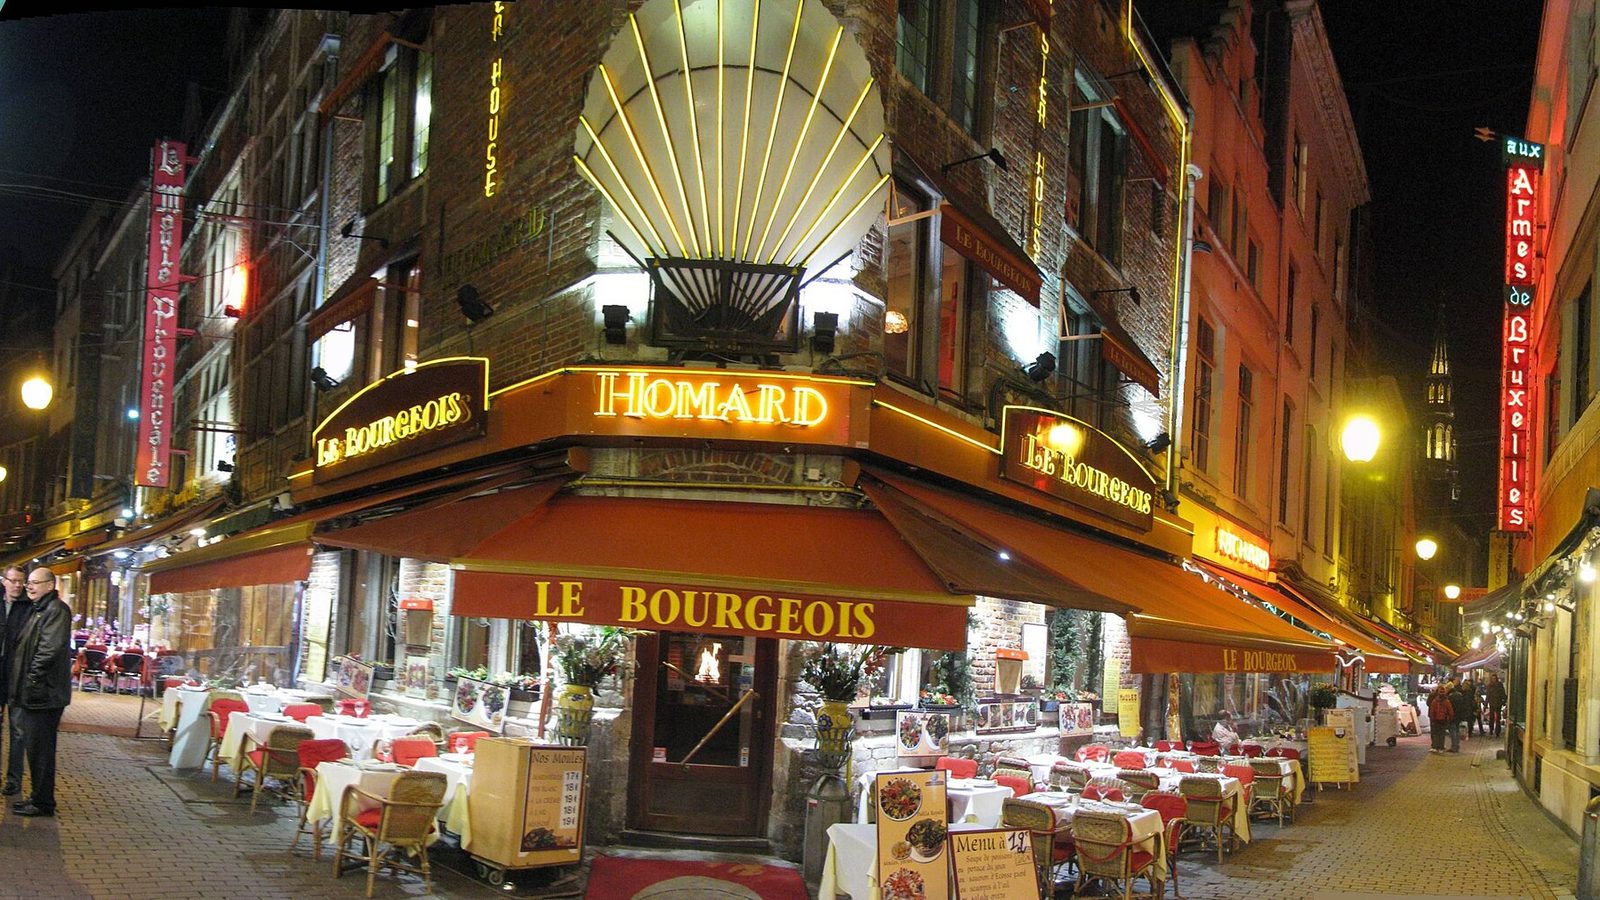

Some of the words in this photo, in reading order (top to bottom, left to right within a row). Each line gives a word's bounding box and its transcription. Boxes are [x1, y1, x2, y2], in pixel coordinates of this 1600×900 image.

[484, 58, 502, 197] HOUSE
[1506, 139, 1541, 158] aux
[1511, 168, 1534, 279] Armes
[956, 224, 972, 249] LE
[976, 239, 1031, 292] BOURGEOIS
[1510, 285, 1530, 306] de
[593, 373, 828, 426] HOMARD
[1507, 315, 1527, 525] Bruxelles
[316, 438, 340, 468] LE
[344, 392, 461, 458] BOURGEOIS
[1024, 433, 1055, 476] LE
[1060, 453, 1152, 515] BOURGEOIS
[534, 581, 584, 617] LE
[618, 586, 876, 638] BOURGEOIS
[1223, 649, 1238, 671] LE
[1243, 650, 1297, 671] BOURGEOIS
[532, 752, 549, 763] Nos
[552, 752, 584, 763] Moules
[957, 836, 996, 853] Menu
[999, 837, 1006, 849] à
